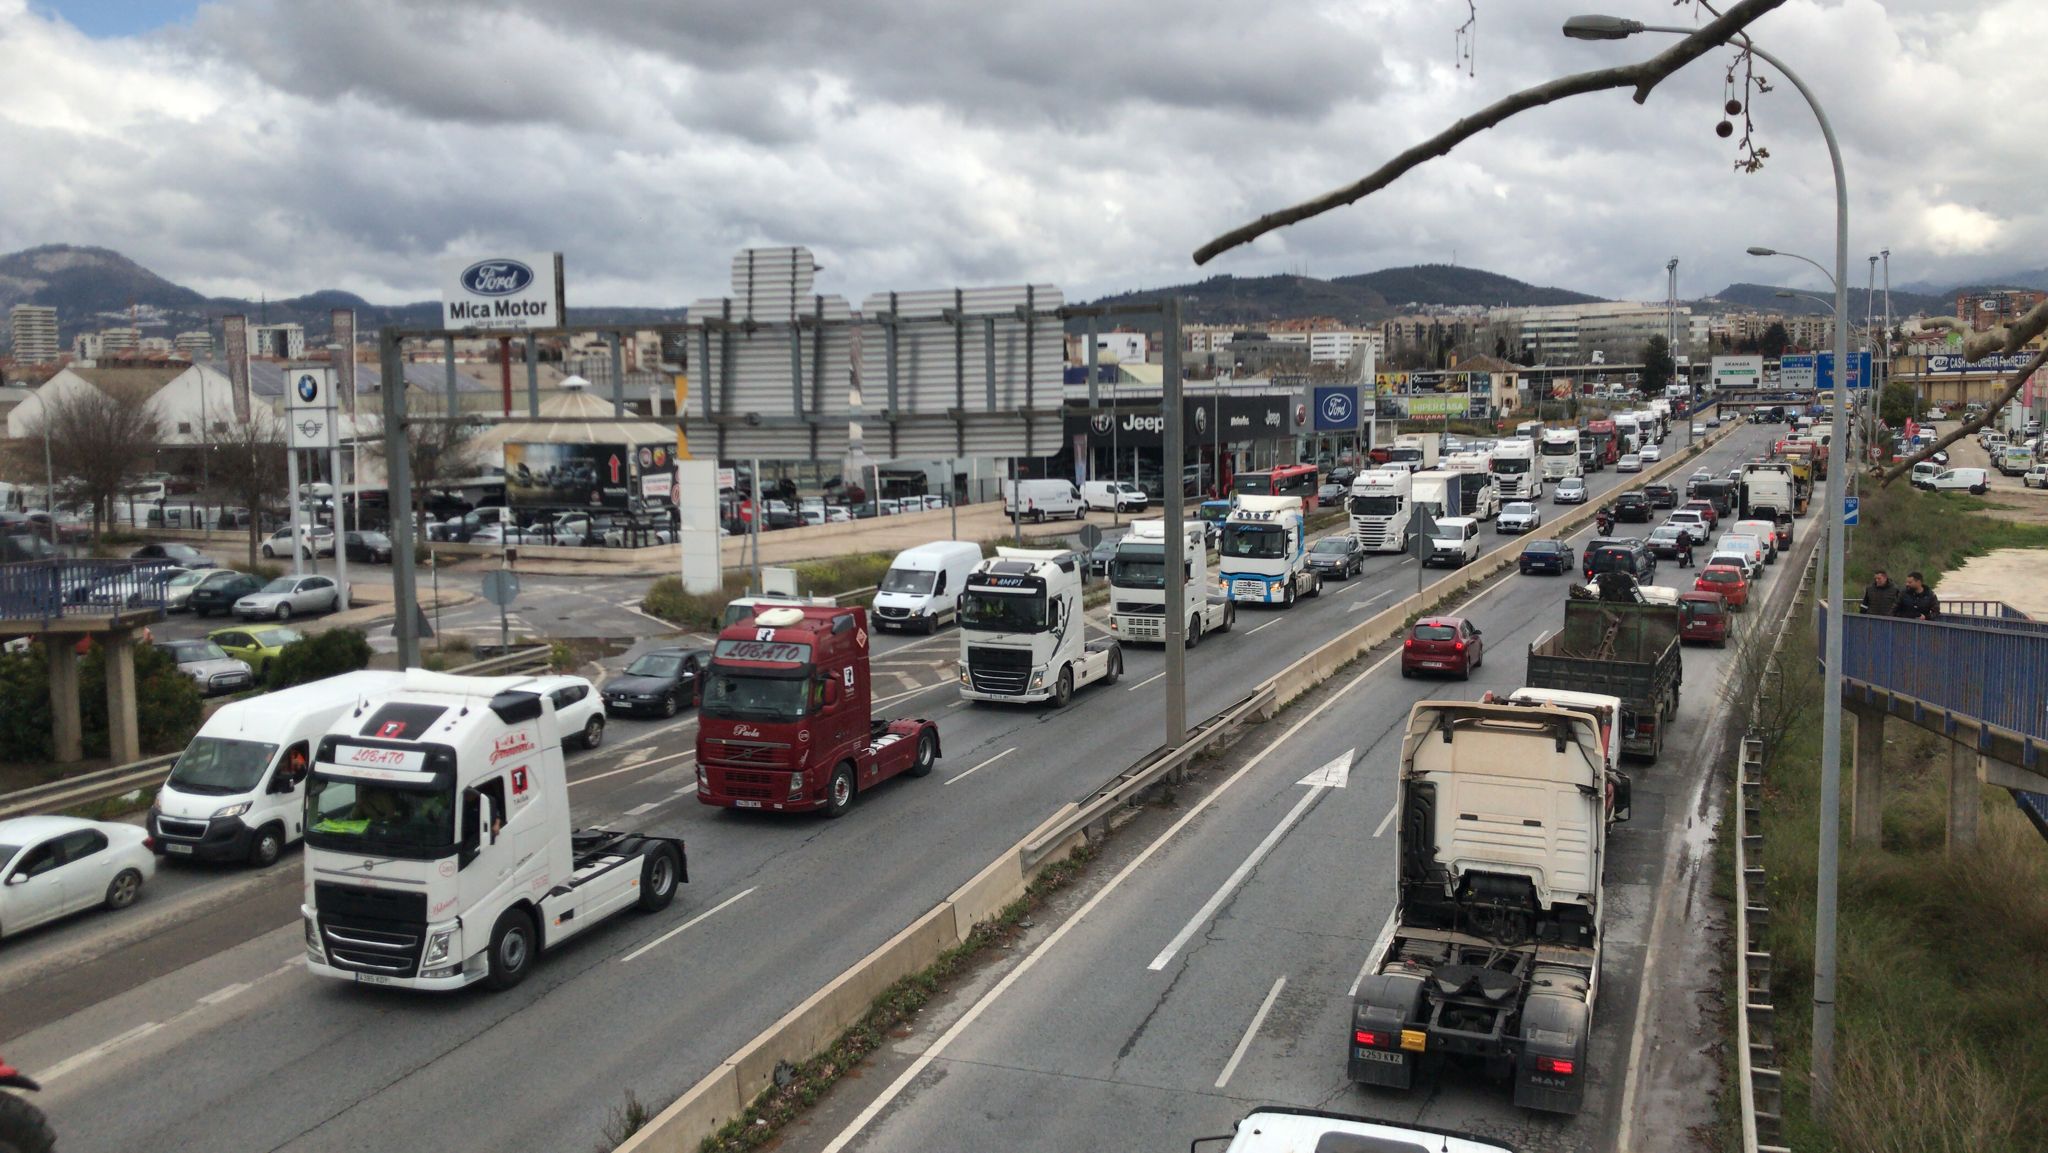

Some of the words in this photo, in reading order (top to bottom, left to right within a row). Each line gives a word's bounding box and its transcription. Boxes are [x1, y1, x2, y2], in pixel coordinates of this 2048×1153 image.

[475, 265, 518, 290] Ford
[450, 301, 490, 319] Mica
[494, 299, 547, 317] Motor
[1950, 357, 1966, 368] CASH
[1328, 397, 1346, 416] Ford
[1122, 413, 1164, 434] Jeep
[1265, 408, 1281, 428] Jeep
[724, 642, 800, 661] LOBATO
[733, 724, 760, 738] Paola
[351, 749, 405, 764] LOBATO
[1531, 1076, 1566, 1087] MAN
